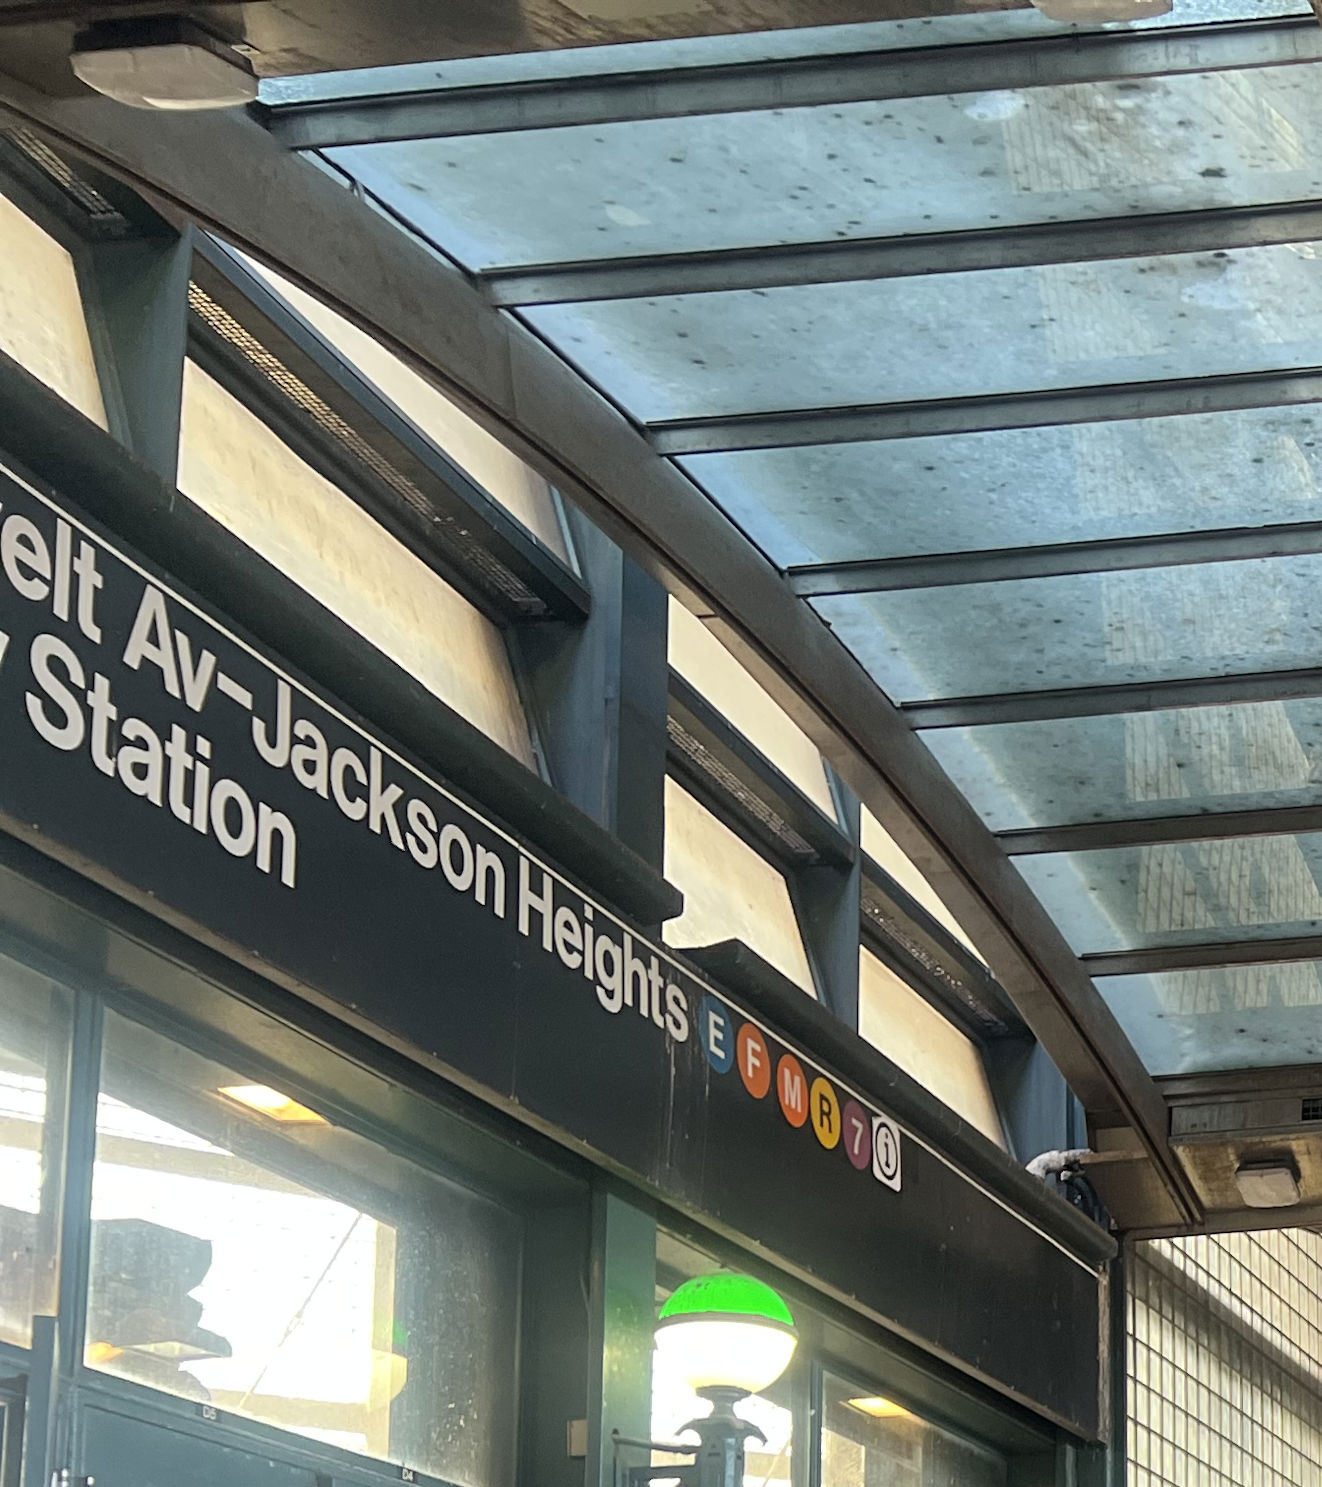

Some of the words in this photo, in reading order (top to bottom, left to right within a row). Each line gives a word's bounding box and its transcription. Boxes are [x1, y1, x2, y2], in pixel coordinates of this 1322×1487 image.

[0, 512, 103, 645] elt
[517, 855, 690, 1043] Heights
[25, 632, 297, 889] Station
